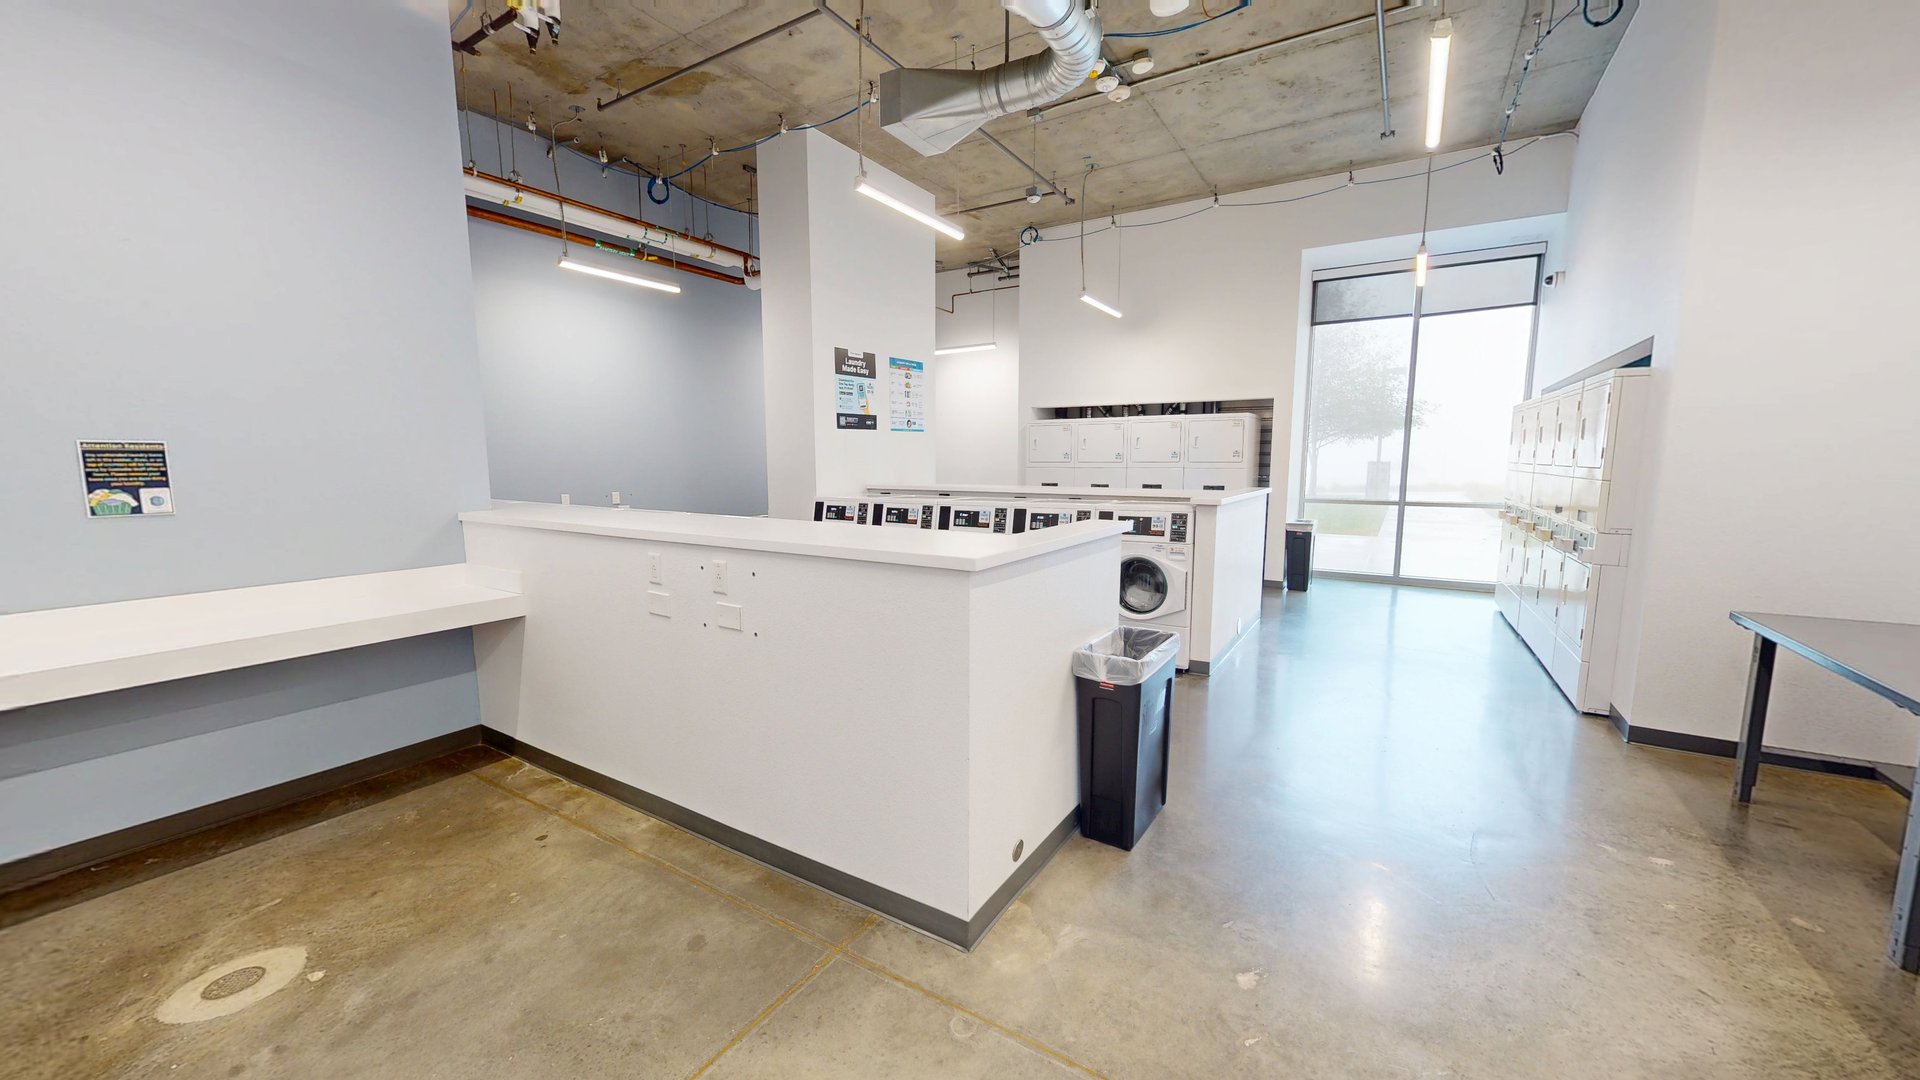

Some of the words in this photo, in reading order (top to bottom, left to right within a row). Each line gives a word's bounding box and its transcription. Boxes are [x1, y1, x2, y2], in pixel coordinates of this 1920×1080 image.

[845, 357, 866, 367] Laundry
[842, 365, 857, 374] Made
[857, 367, 869, 376] Easy
